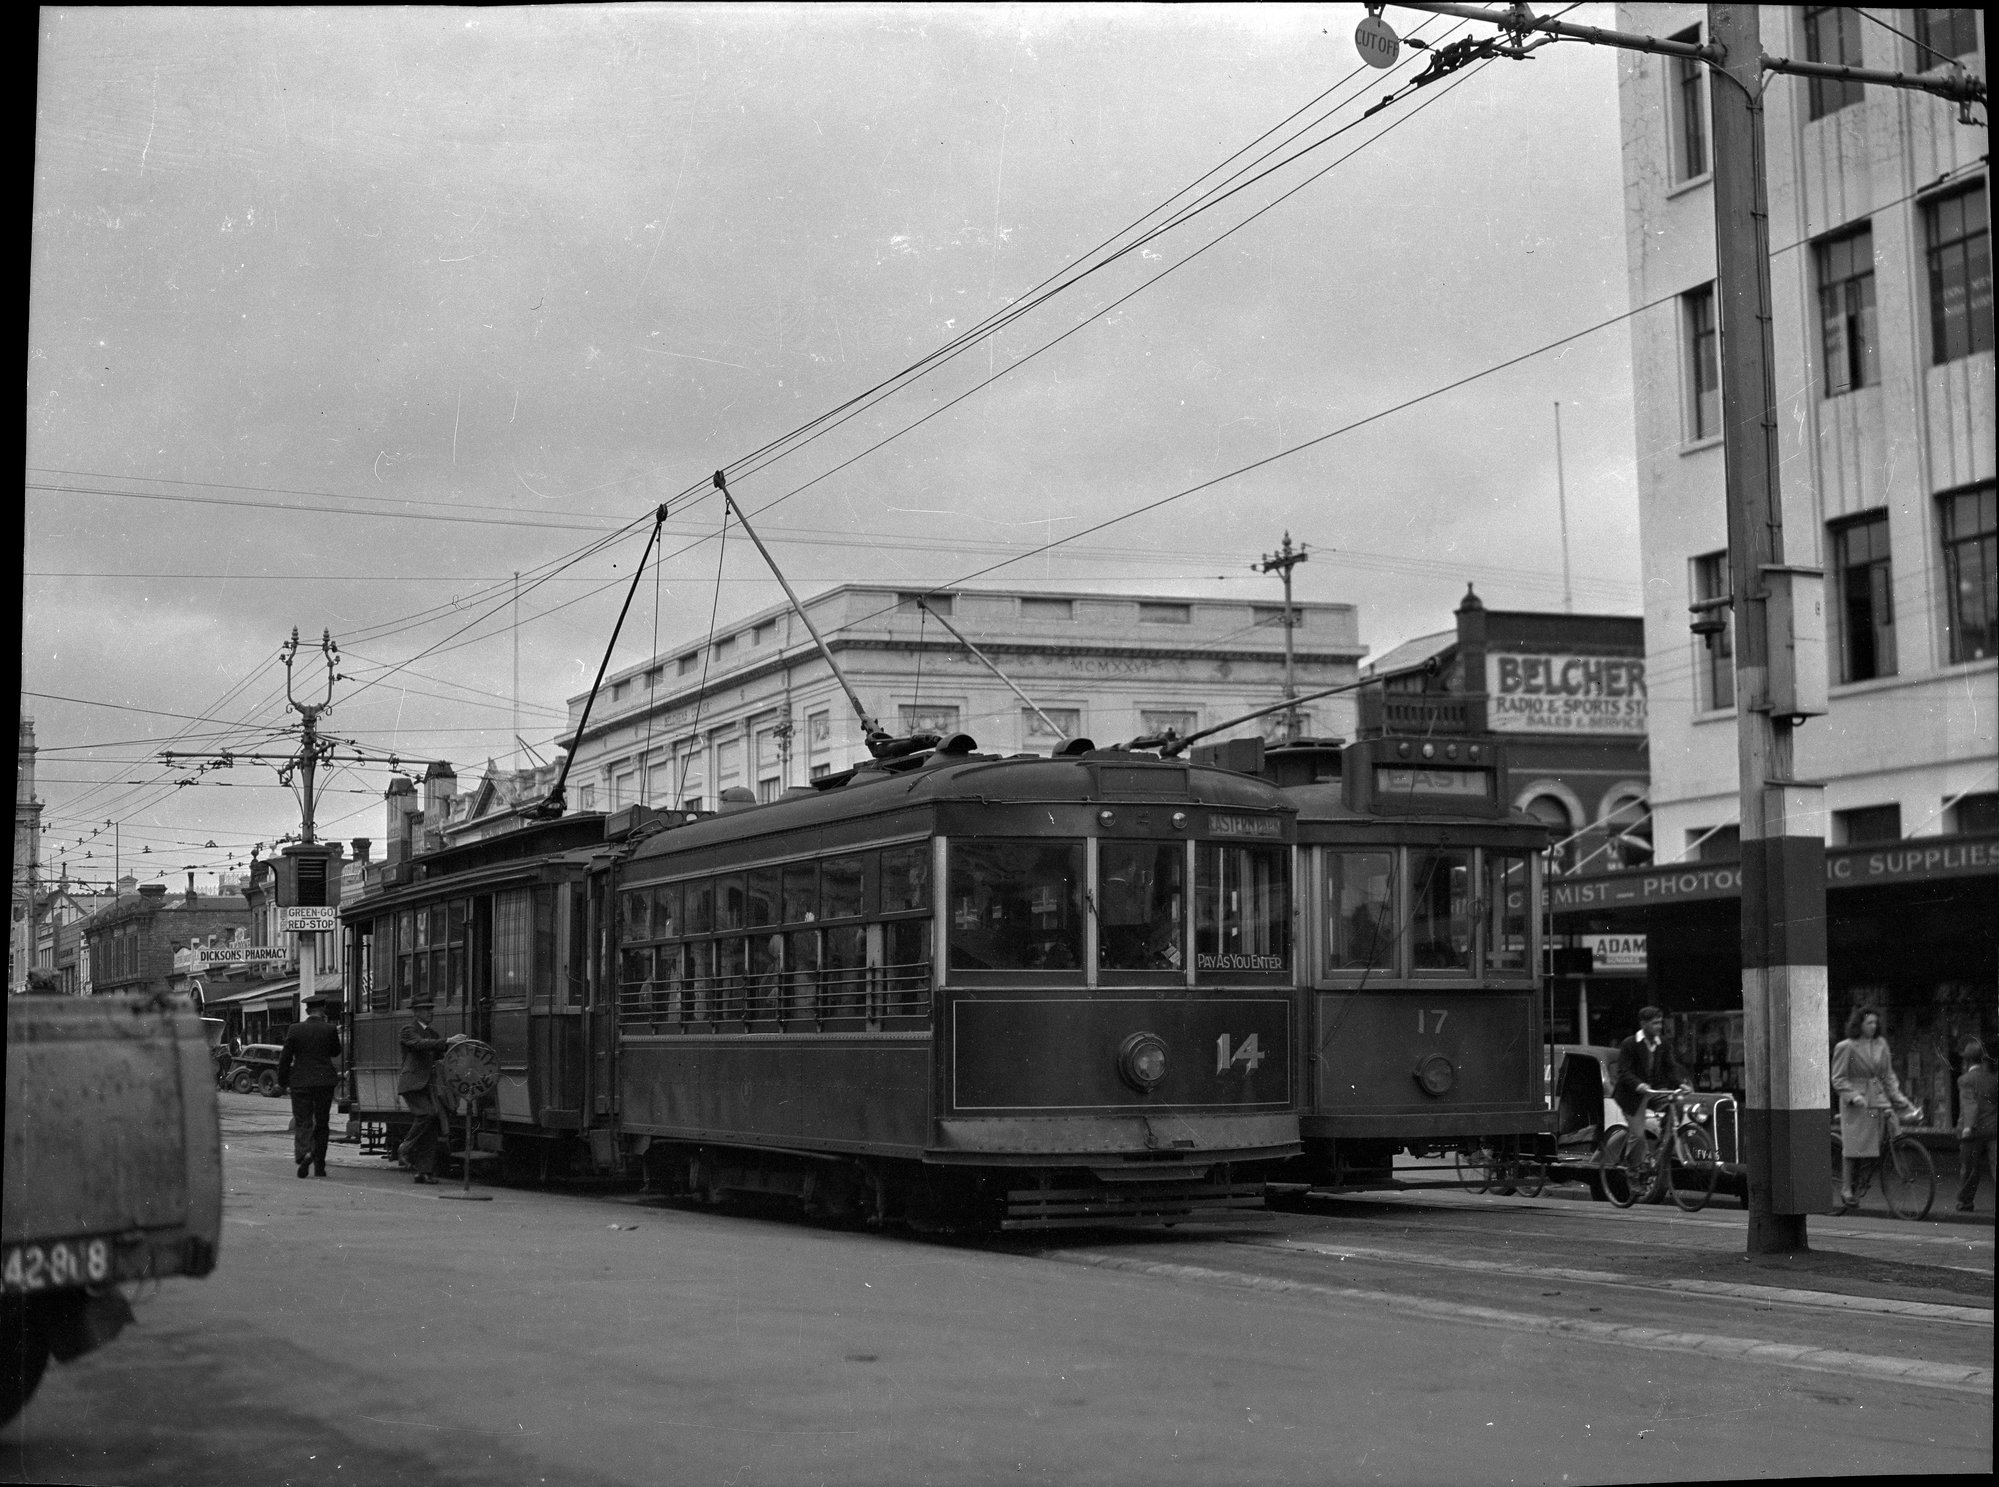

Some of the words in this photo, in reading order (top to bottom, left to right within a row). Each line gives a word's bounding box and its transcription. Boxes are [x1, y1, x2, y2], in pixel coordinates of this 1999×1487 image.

[1356, 29, 1378, 49] CUT
[1379, 37, 1399, 57] OFF
[1498, 656, 1648, 699] BELCHER
[1498, 698, 1543, 714] RADIO
[1563, 699, 1620, 716] SPORTS
[1507, 883, 1609, 909] CEMIST
[288, 920, 334, 929] RED-STOP
[200, 950, 241, 961] DICKSONS
[245, 948, 288, 960] PHARMACY
[1251, 953, 1282, 969] ENTER
[1417, 1009, 1448, 1034] 17
[1216, 1033, 1265, 1076] 14
[446, 1074, 495, 1097] ZONE
